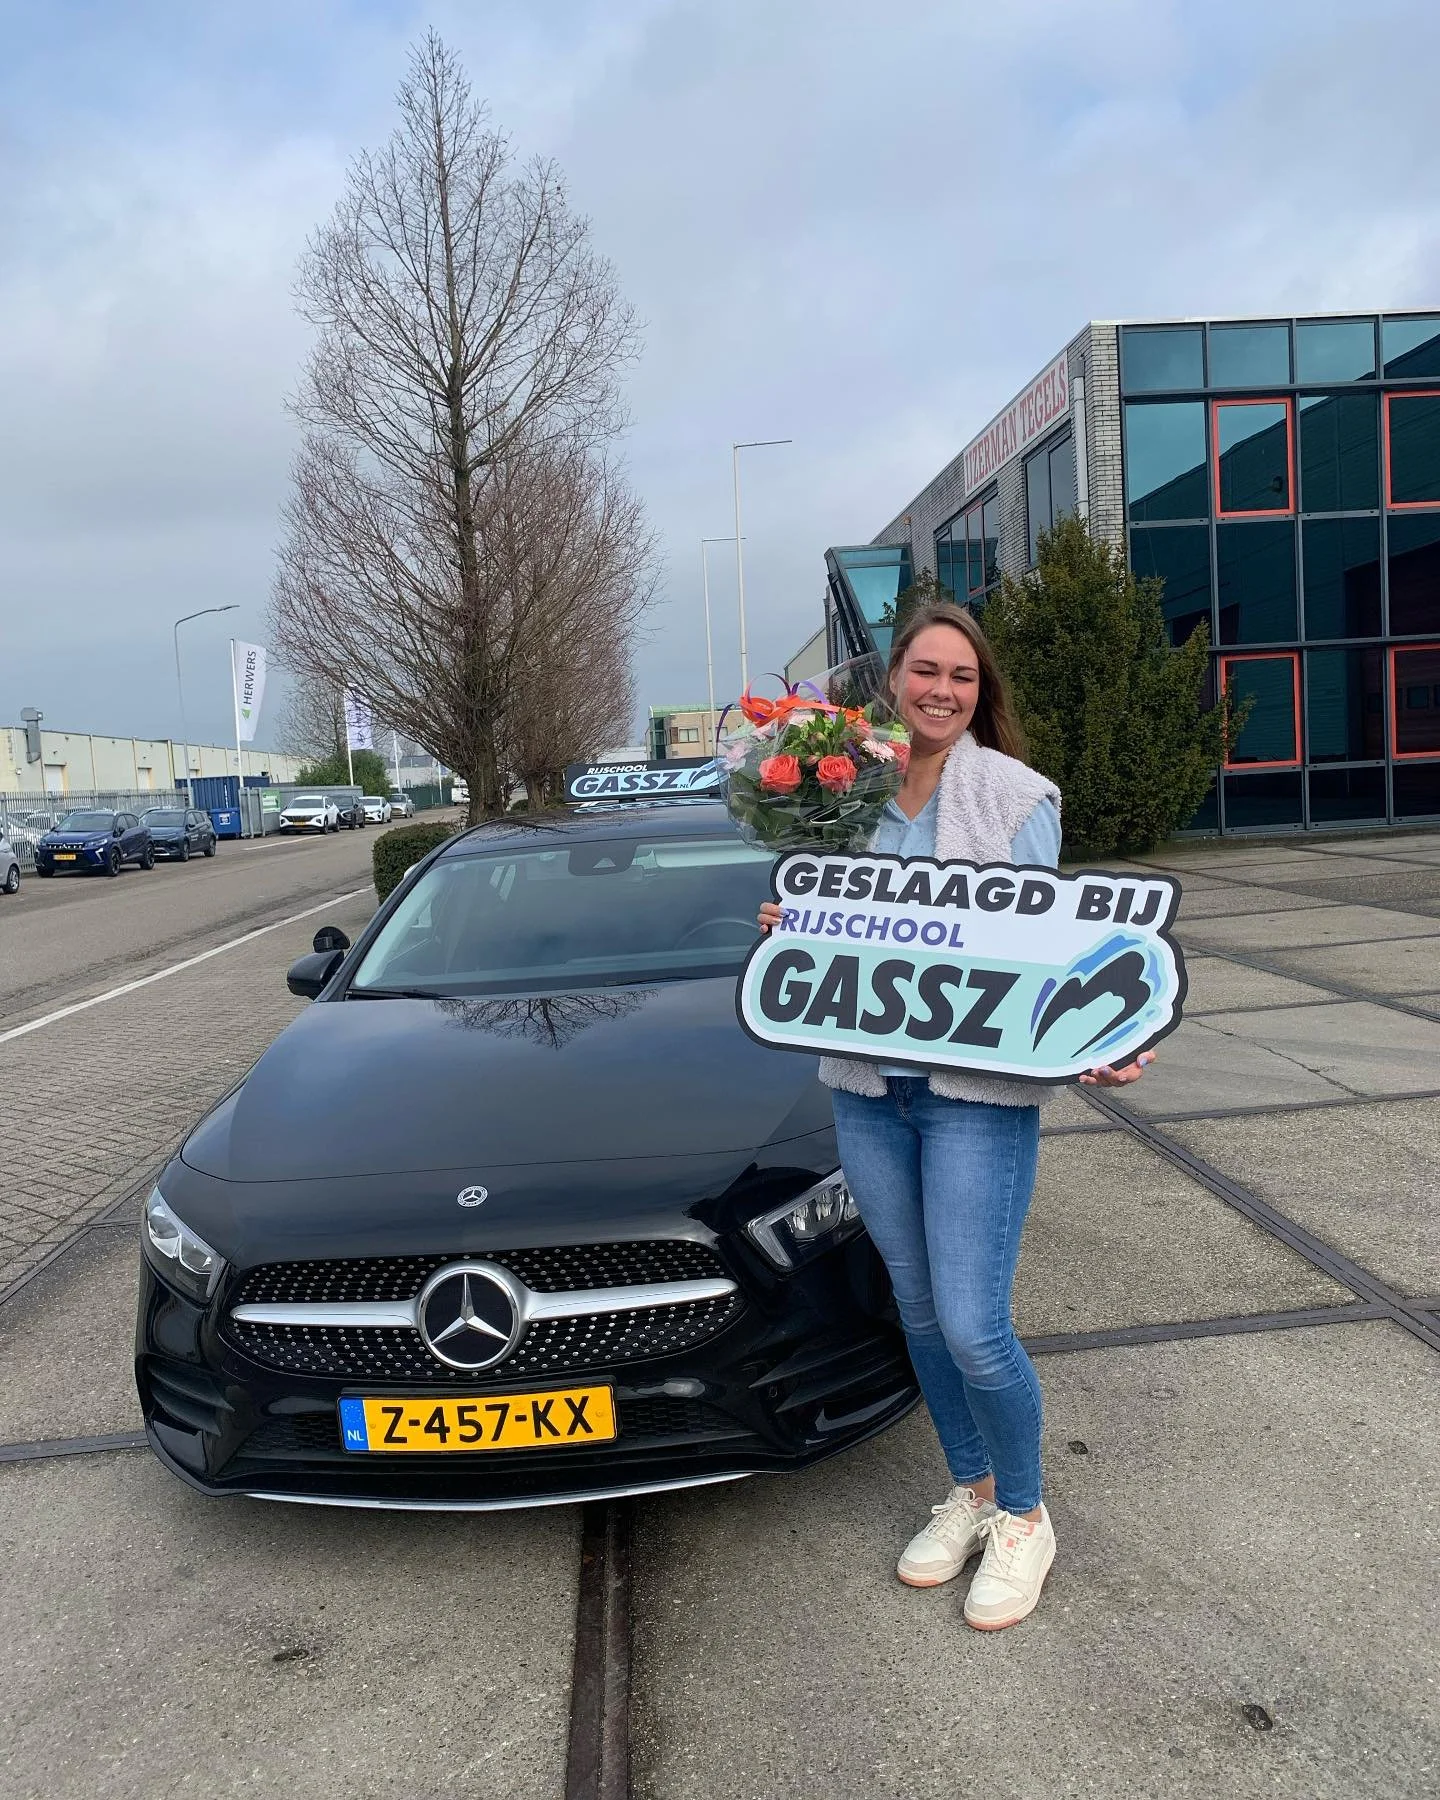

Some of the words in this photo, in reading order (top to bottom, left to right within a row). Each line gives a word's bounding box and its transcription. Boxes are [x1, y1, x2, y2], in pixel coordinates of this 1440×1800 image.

[1020, 360, 1066, 442] TEGELS
[243, 650, 257, 705] HERWERS
[587, 764, 648, 775] RIJSCHOOL
[783, 861, 1056, 916] GESLAAGD
[1075, 884, 1164, 926] BIJ
[780, 908, 965, 948] RIJSCHOOL
[759, 949, 1021, 1049] GASSZ
[347, 1430, 365, 1442] NL
[381, 1395, 594, 1444] Z-457-KX
